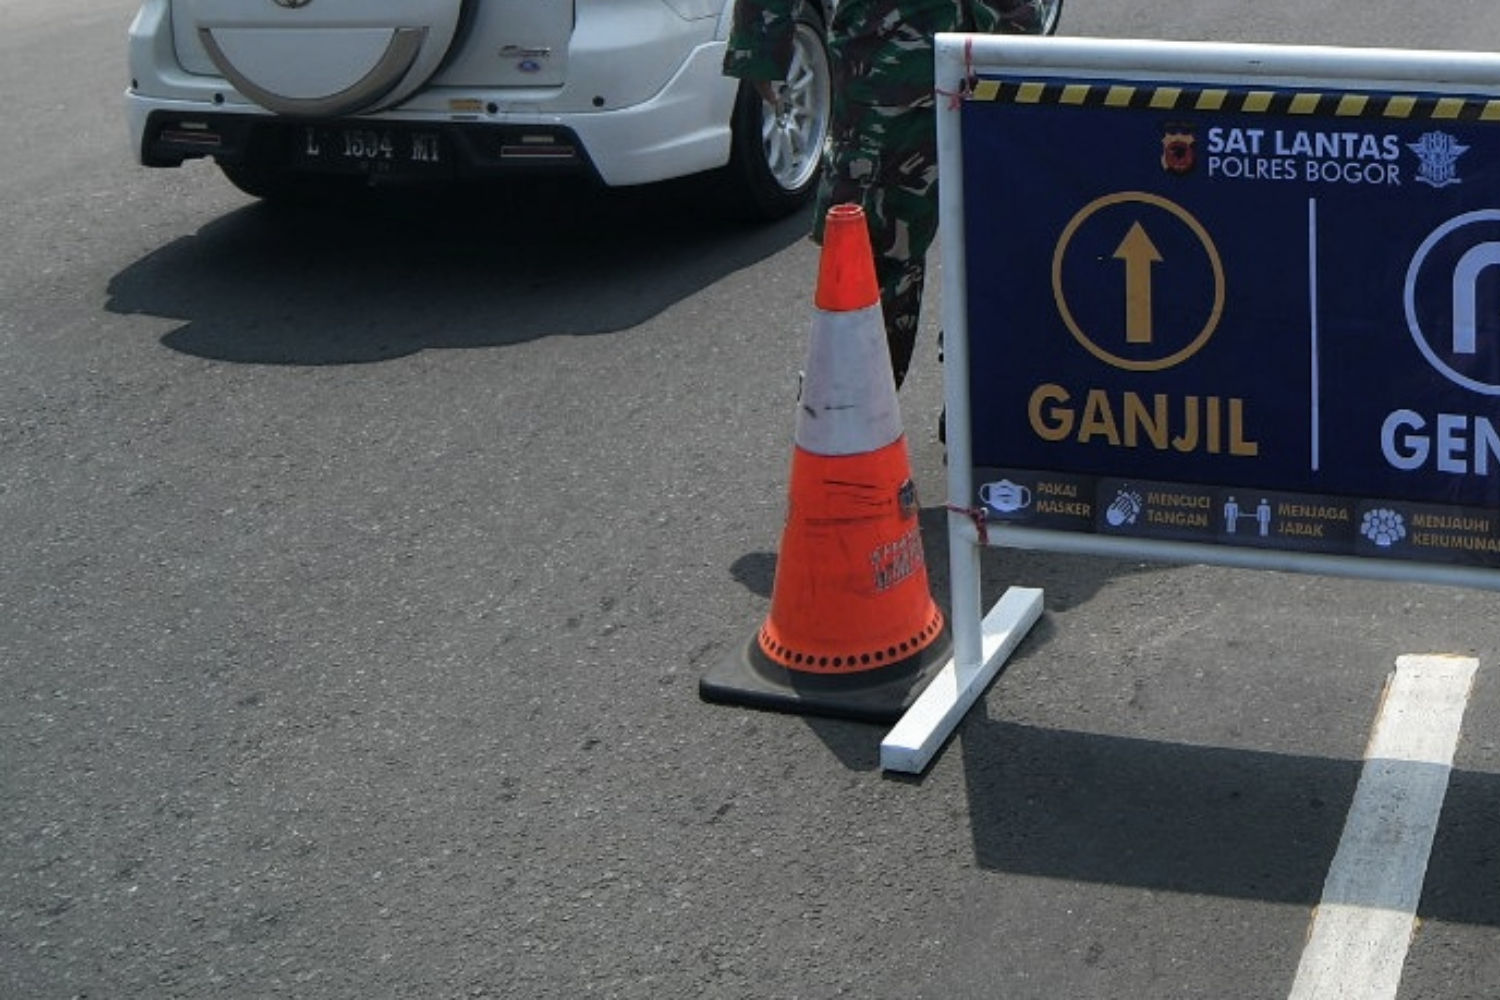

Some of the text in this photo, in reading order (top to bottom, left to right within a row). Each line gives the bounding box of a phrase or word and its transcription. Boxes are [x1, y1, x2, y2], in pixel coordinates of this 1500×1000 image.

[1207, 127, 1400, 160] SAT LANTAS
[1208, 156, 1401, 186] POLRES BOGOR
[1027, 382, 1259, 457] GANJIL
[1037, 482, 1078, 497] PAKAI
[1036, 500, 1091, 517] MASKER
[1148, 491, 1211, 508] MENCUCI
[1148, 509, 1209, 527] TANGAN
[1277, 503, 1349, 522] MENJAGA
[1277, 521, 1324, 538] JARAK
[1412, 513, 1490, 531] MENJAUHI
